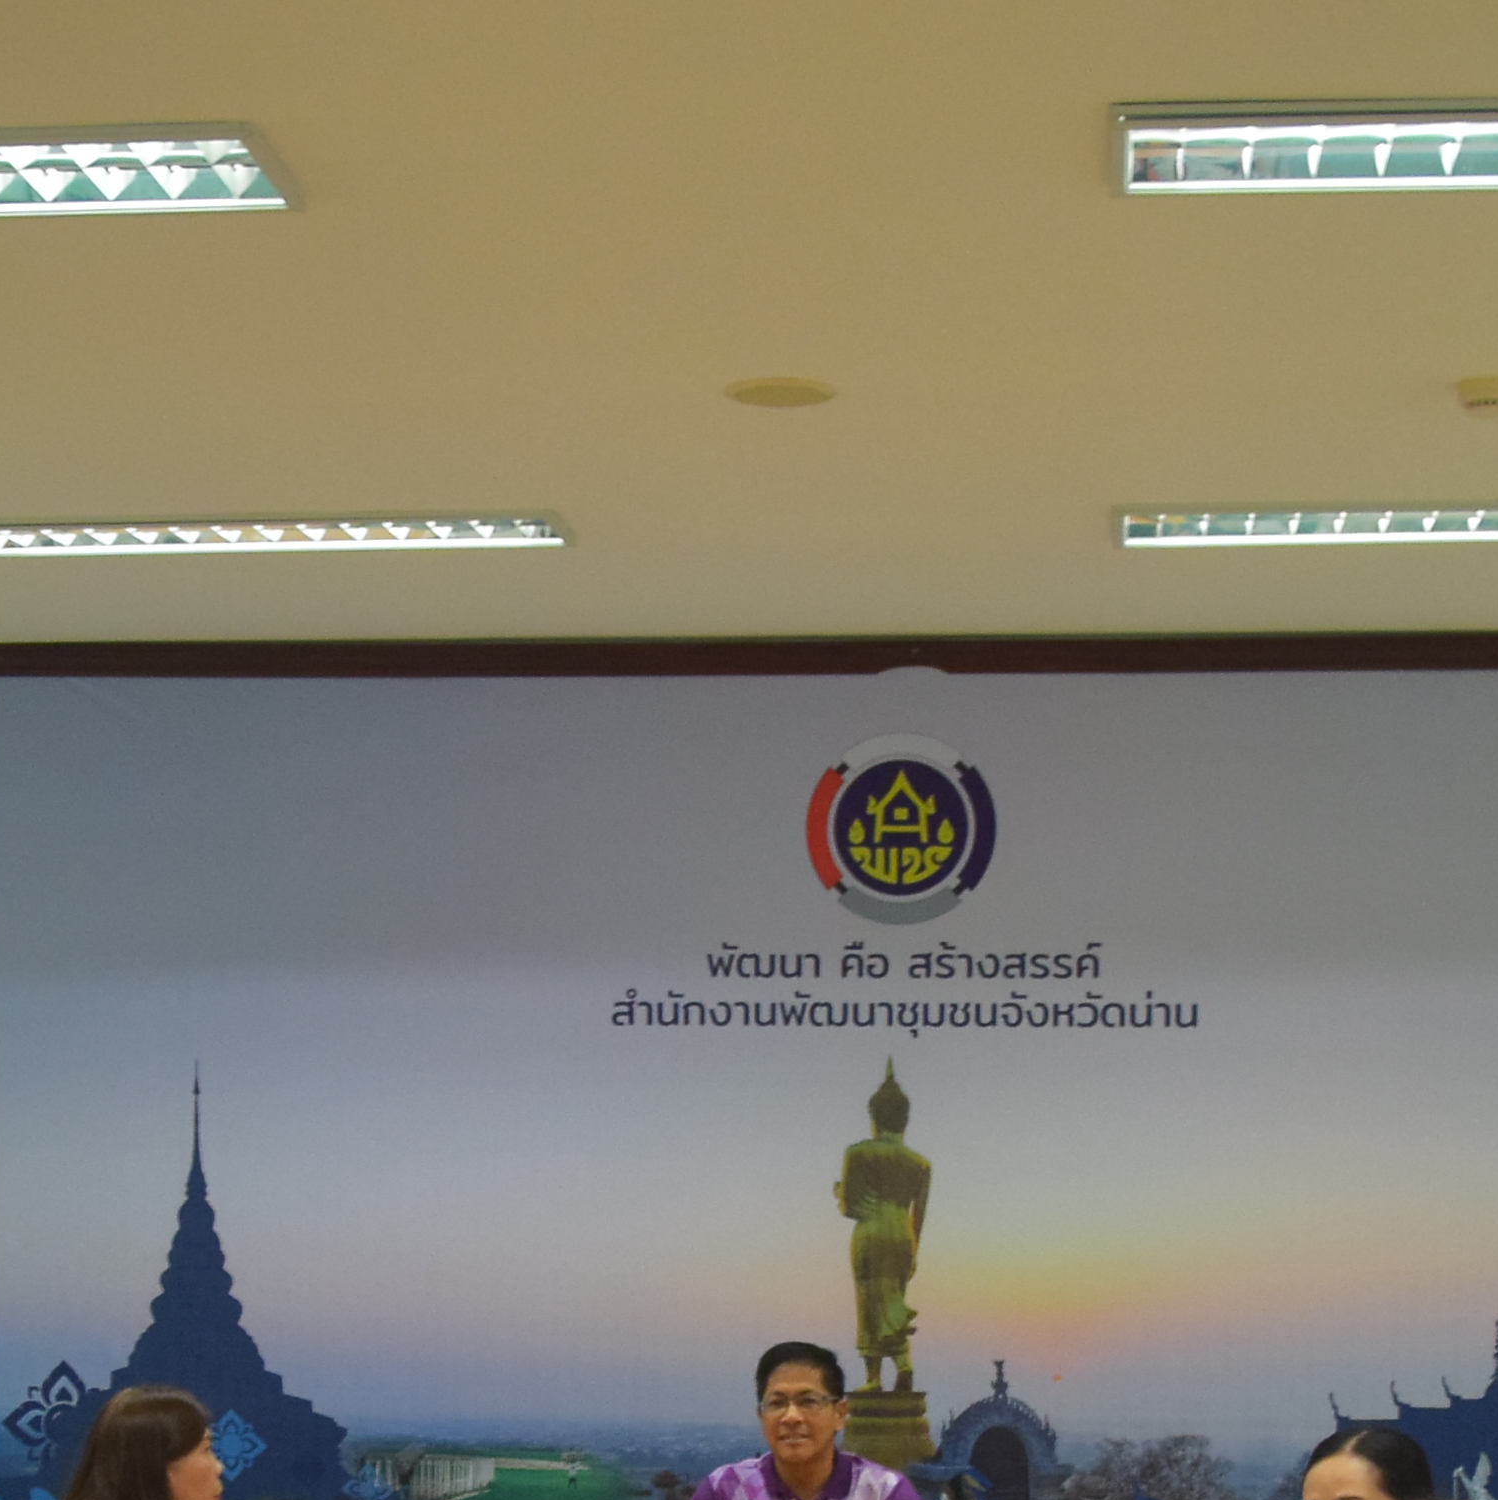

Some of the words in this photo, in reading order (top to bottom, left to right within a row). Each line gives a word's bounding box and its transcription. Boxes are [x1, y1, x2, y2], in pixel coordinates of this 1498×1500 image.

[706, 941, 821, 979] พัฒนา
[840, 940, 890, 979] คือ
[907, 941, 1102, 980] สร้างสรรค์
[610, 988, 1199, 1038] สำนักงานพัฒนาชุมชนจังหวัดน่าน
